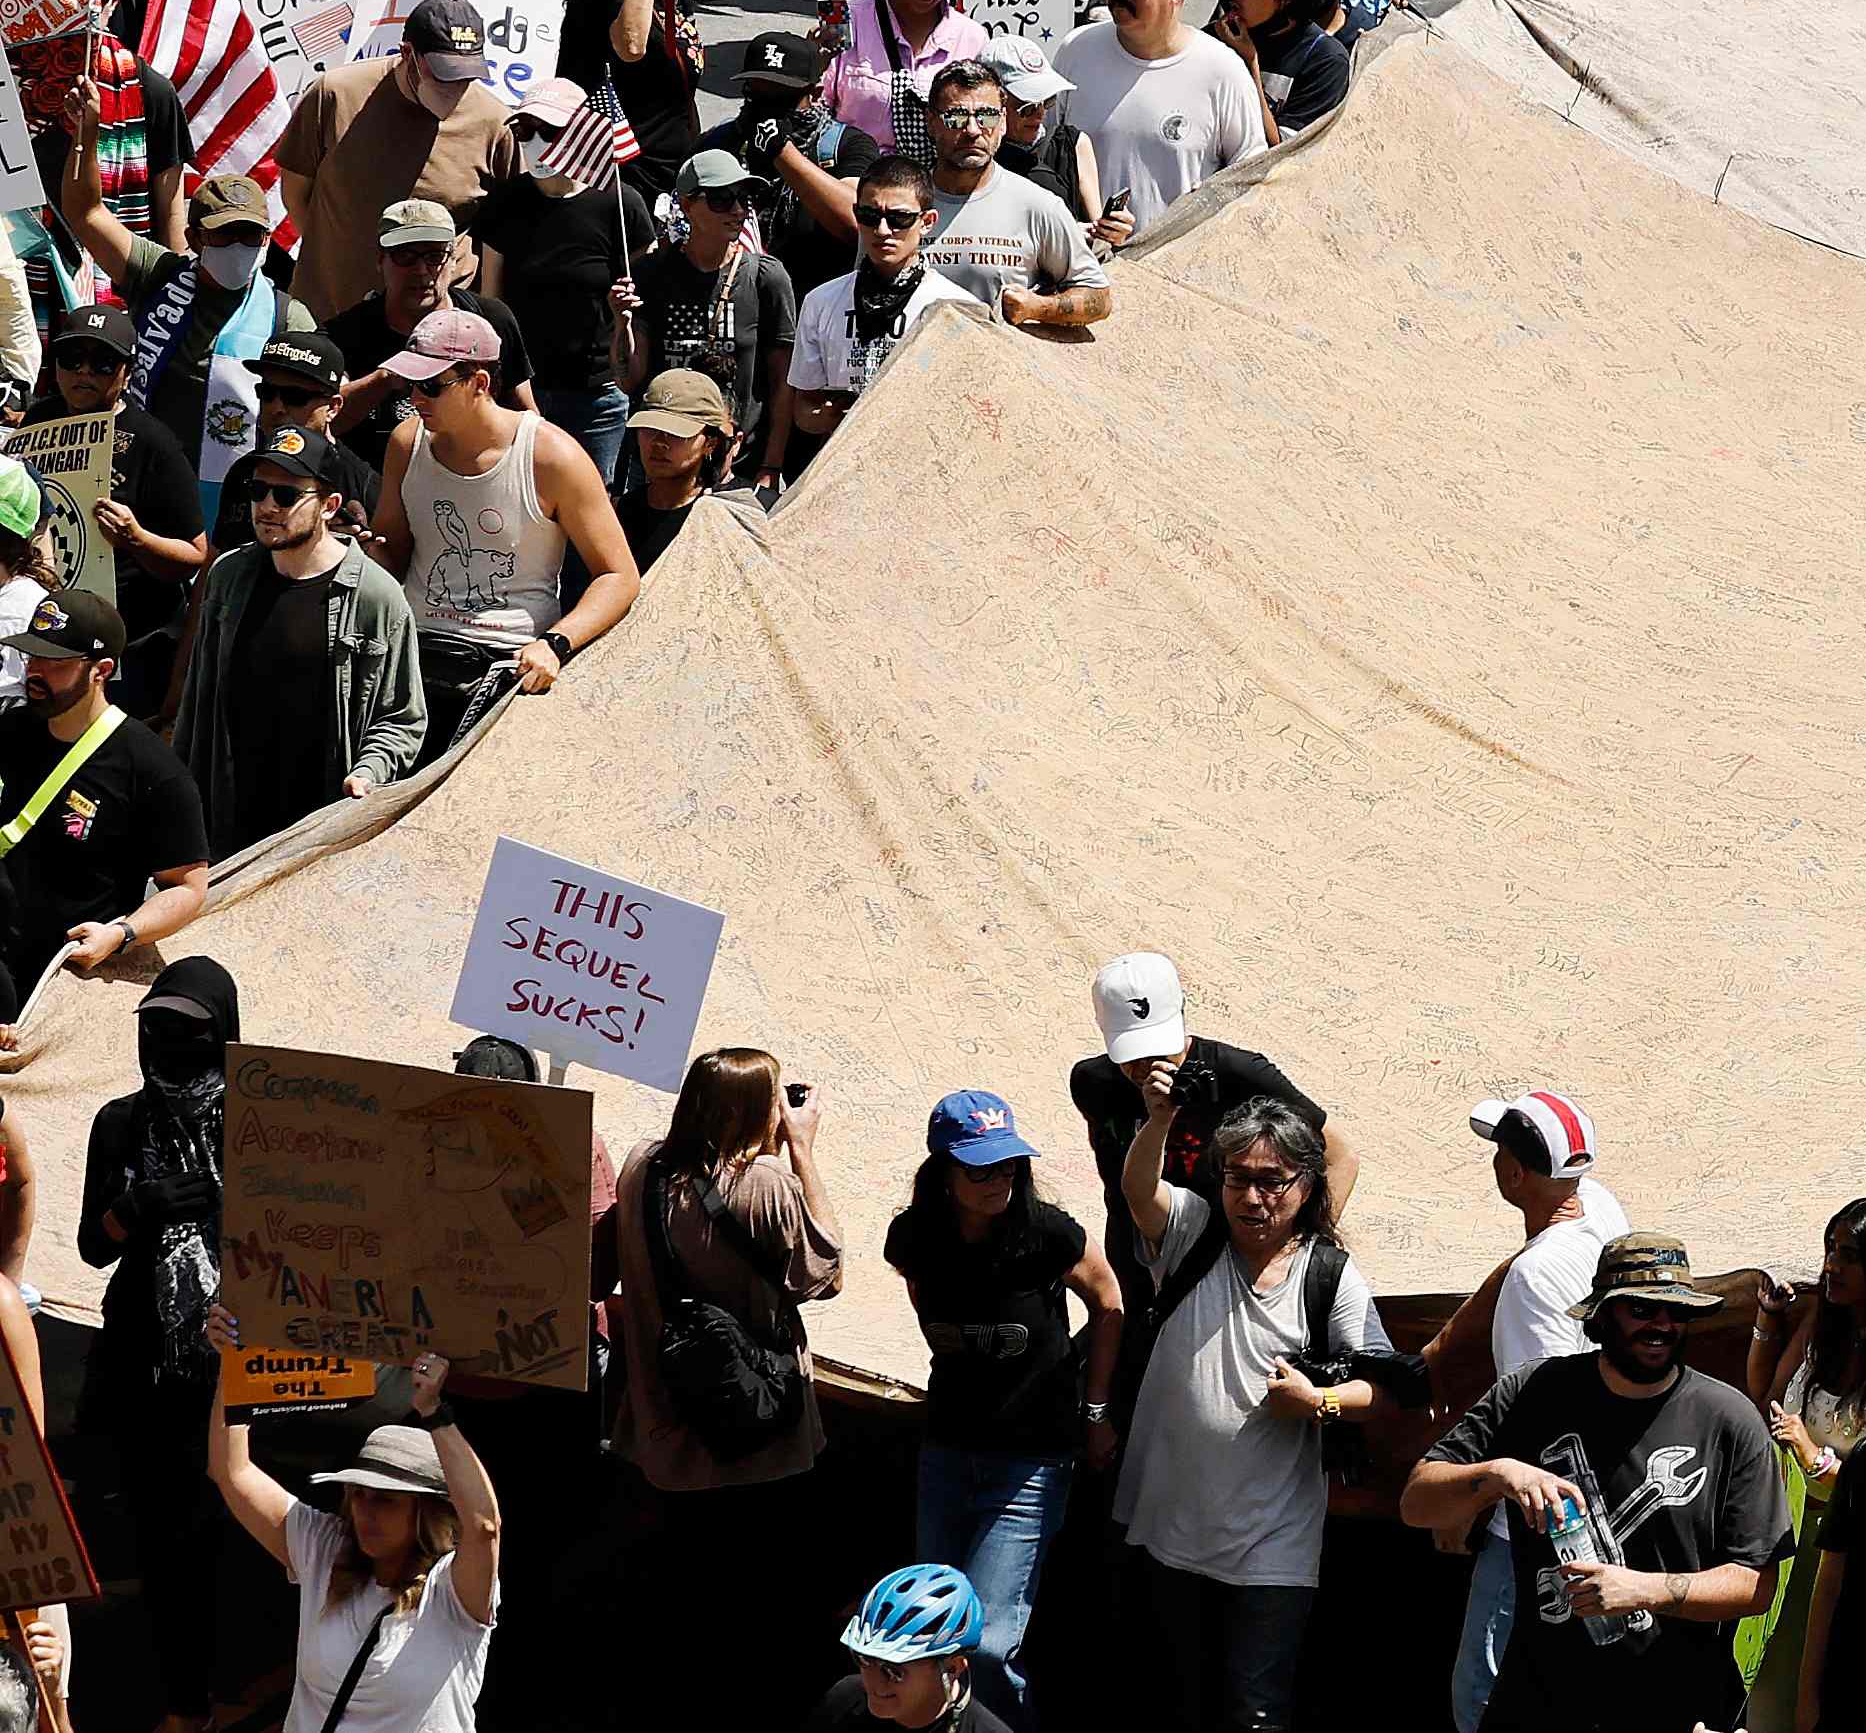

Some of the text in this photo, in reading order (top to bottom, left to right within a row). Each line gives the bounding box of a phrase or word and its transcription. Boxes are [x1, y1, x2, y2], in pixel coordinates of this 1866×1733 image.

[550, 877, 654, 941] THIS
[501, 915, 666, 1006] SEQUEL
[504, 975, 646, 1051] SUCKS!
